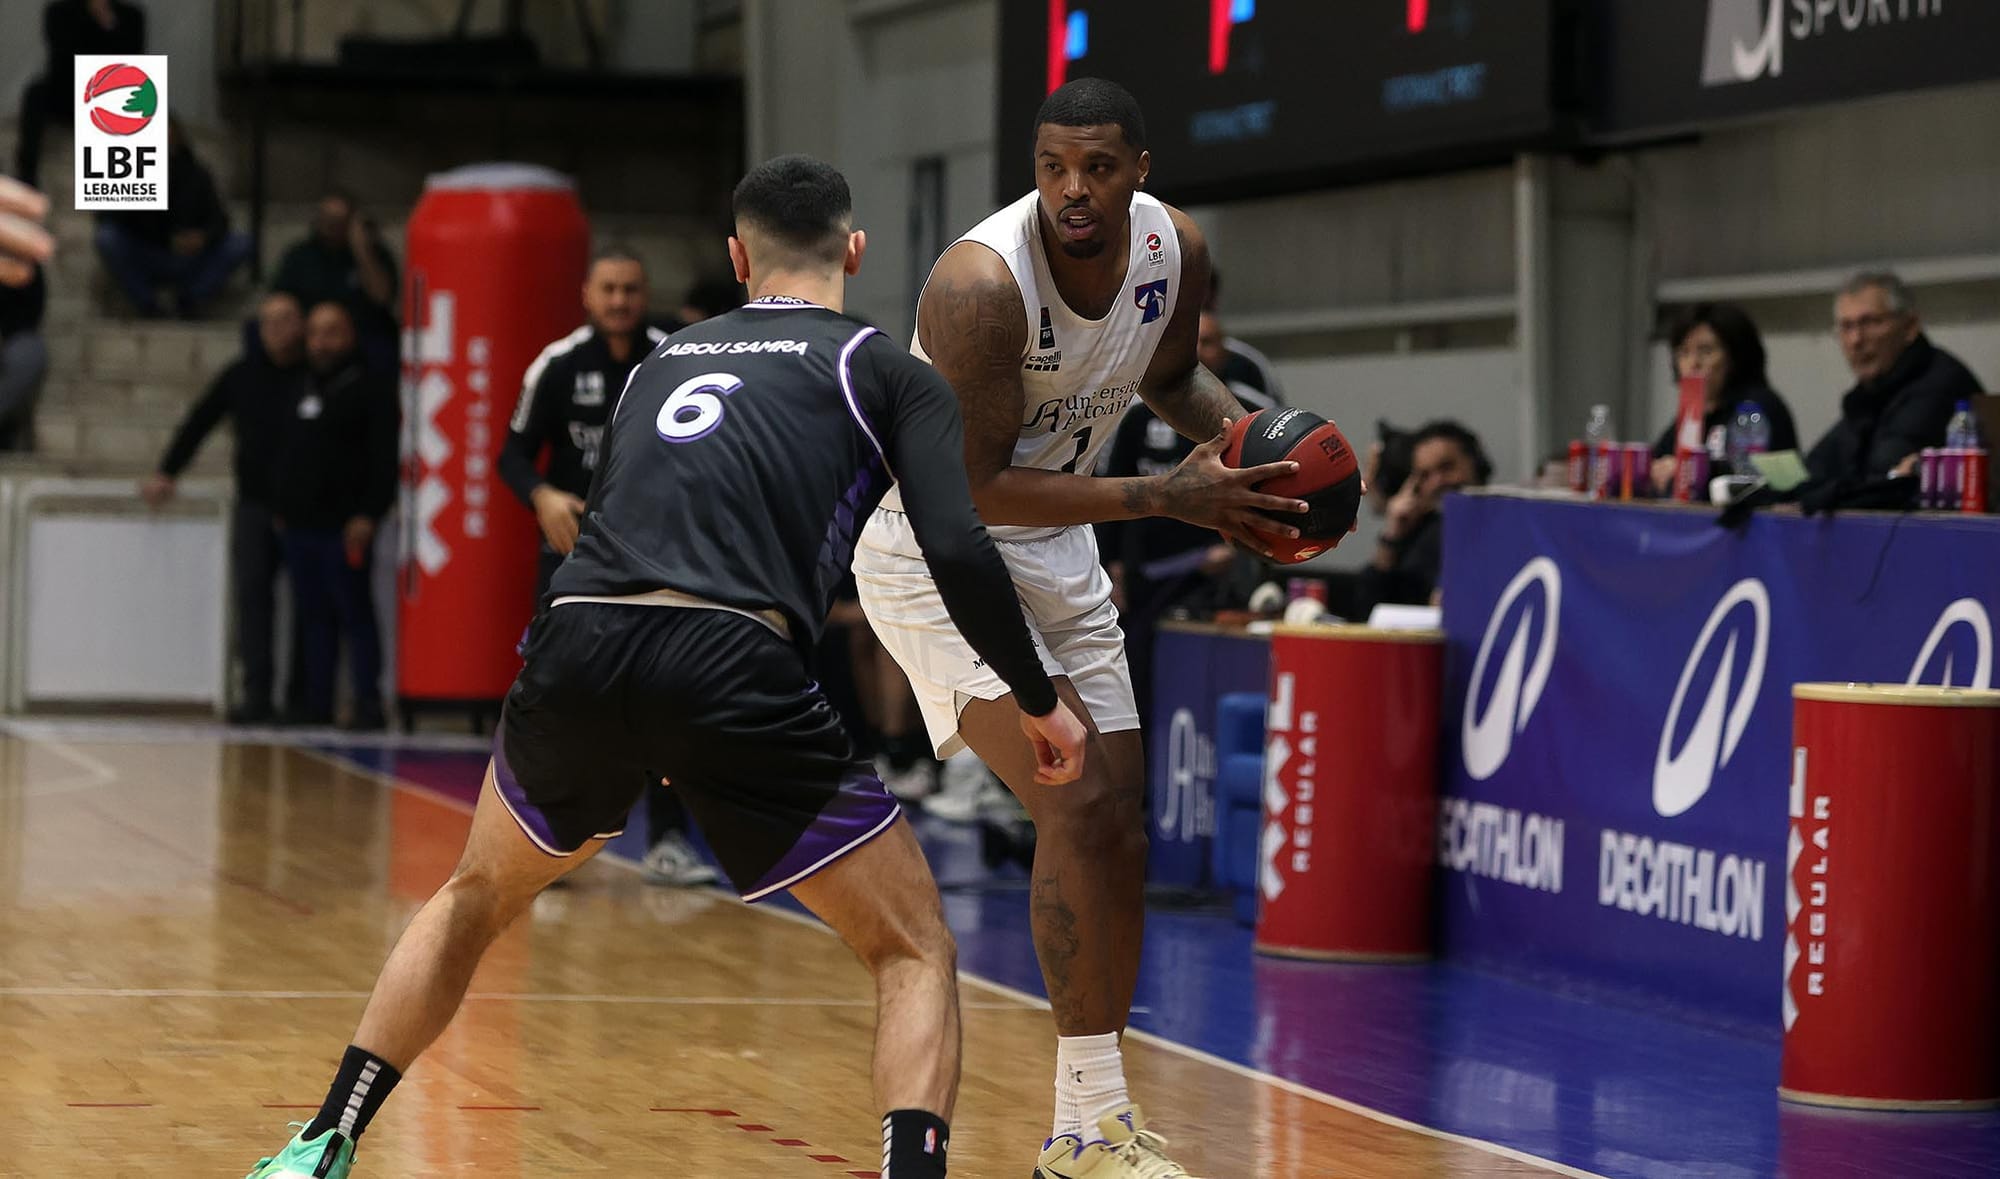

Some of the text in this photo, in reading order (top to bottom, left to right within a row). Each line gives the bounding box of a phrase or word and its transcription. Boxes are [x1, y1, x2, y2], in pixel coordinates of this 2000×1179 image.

[1148, 251, 1163, 261] LBF
[659, 340, 809, 358] ABOU SAMRA
[1029, 351, 1062, 364] capelli
[656, 372, 744, 443] 6
[1061, 426, 1093, 474] 1
[1292, 711, 1318, 873] REGULAR
[1440, 797, 1565, 895] ECATHLON
[1599, 828, 1767, 942] DECATHLON
[1808, 796, 1831, 996] REGULAR
